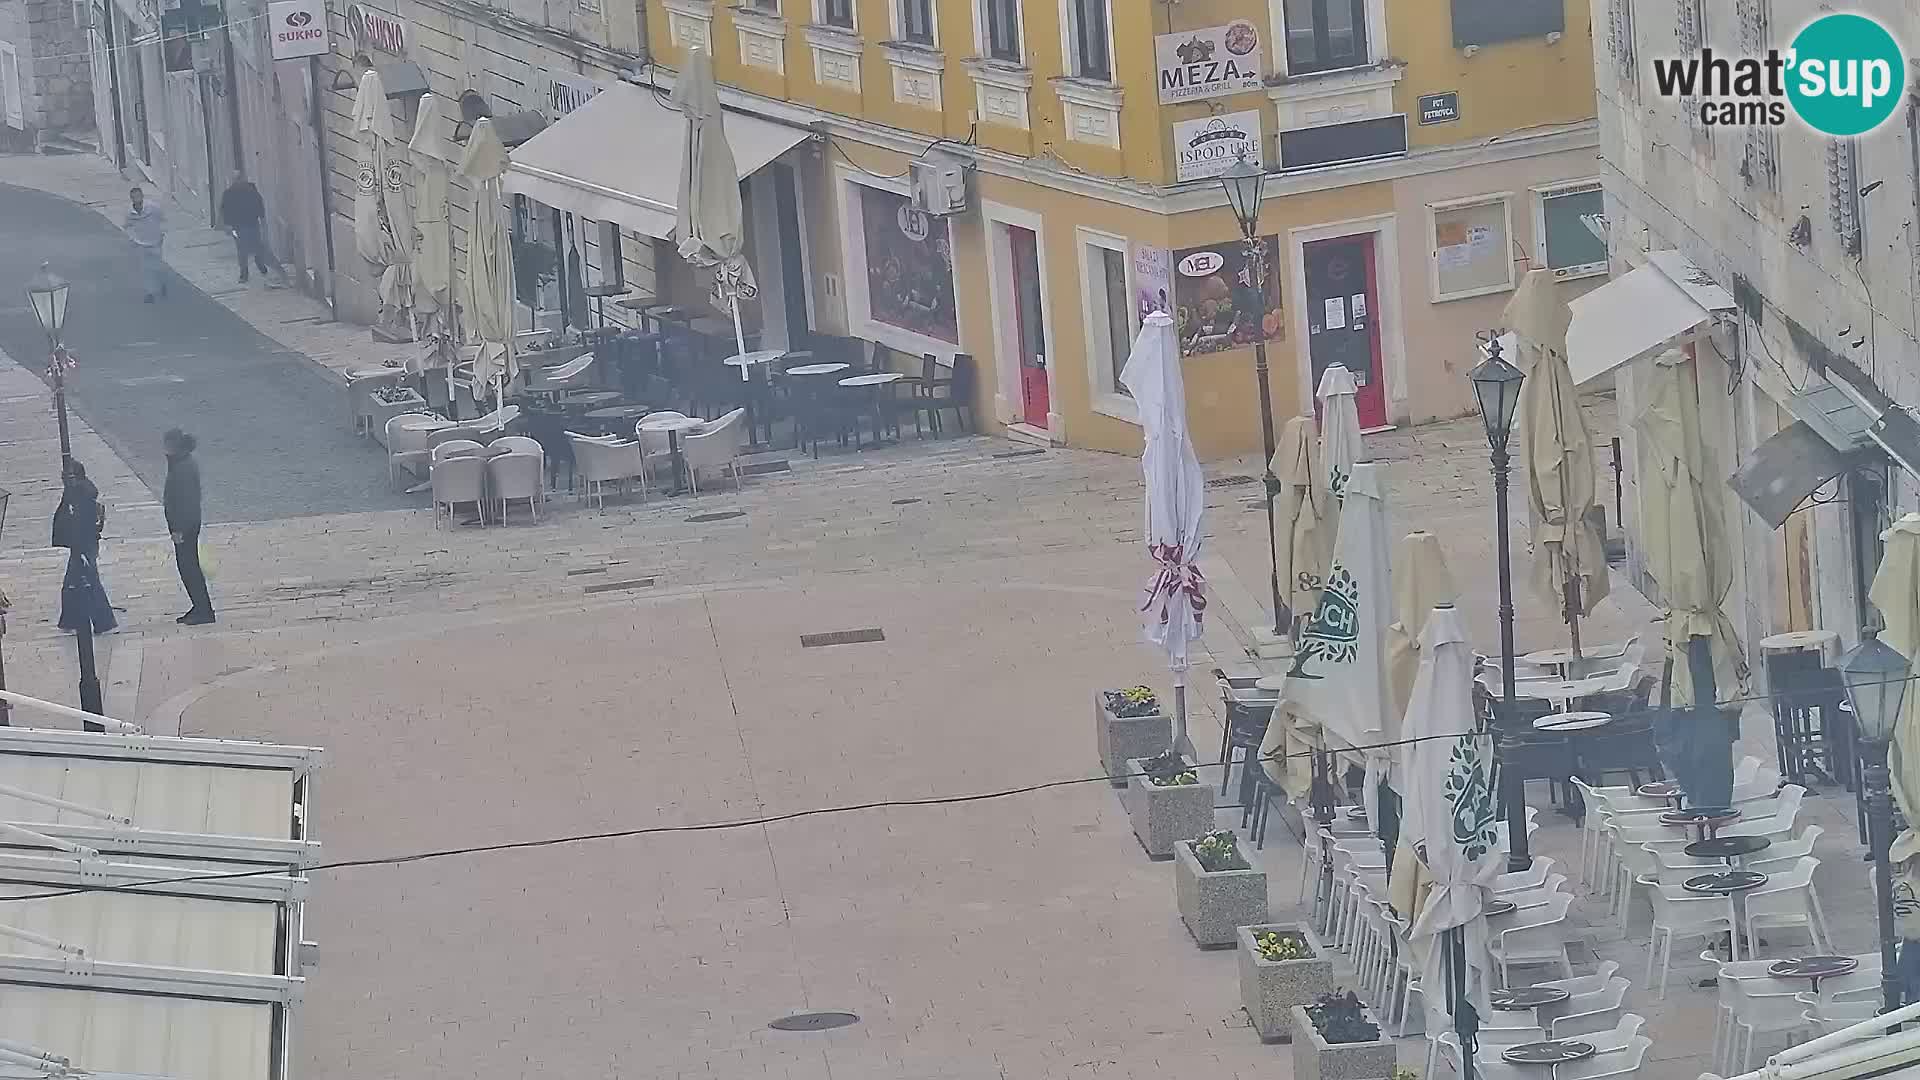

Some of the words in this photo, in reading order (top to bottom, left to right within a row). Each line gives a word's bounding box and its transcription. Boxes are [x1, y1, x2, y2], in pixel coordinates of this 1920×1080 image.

[278, 28, 323, 42] SUKNO
[364, 12, 404, 53] SUKNO
[1161, 59, 1240, 90] MEZA
[1171, 85, 1203, 98] PIZZERIA
[1211, 81, 1232, 93] GRILL
[1180, 145, 1225, 164] ISPOD
